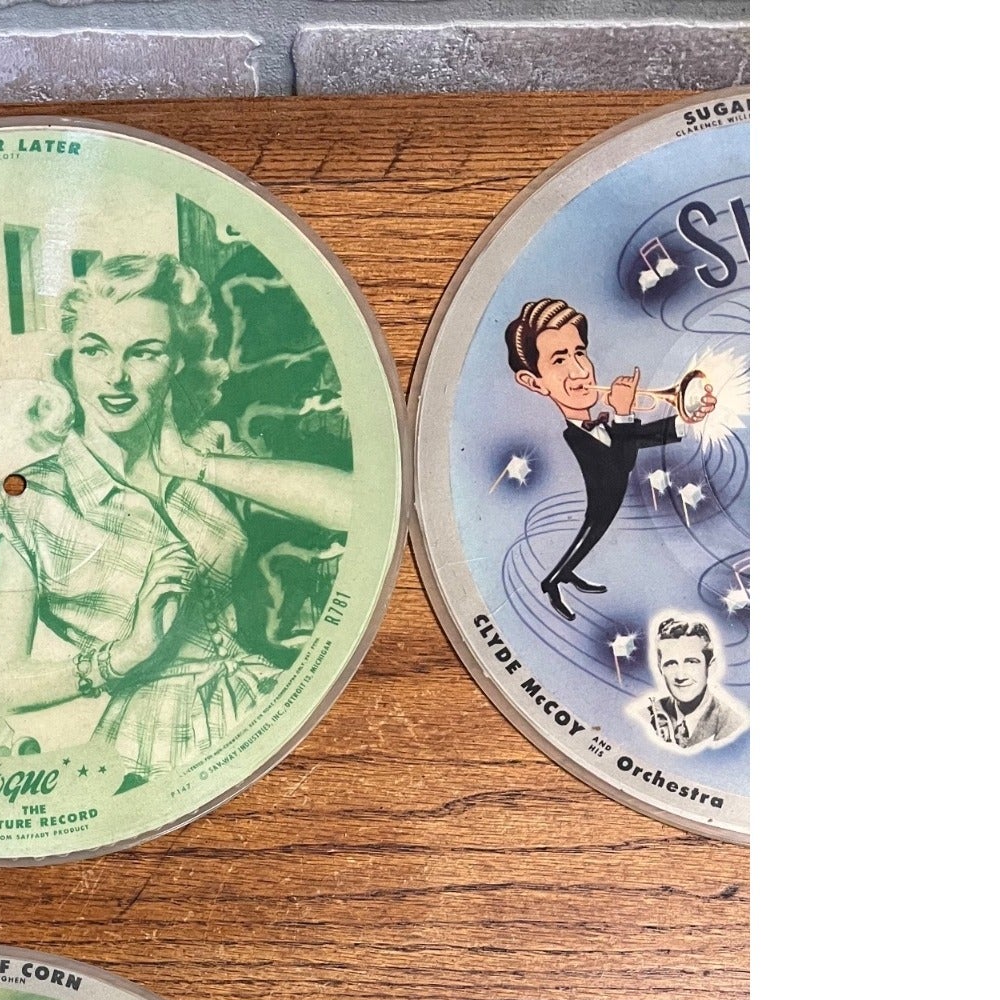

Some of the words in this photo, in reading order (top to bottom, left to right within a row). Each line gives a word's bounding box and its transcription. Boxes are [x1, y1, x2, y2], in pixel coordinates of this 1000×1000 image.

[683, 99, 750, 125] SUGA
[675, 119, 722, 137] CLARENCE
[18, 139, 81, 156] LATER
[324, 591, 351, 626] R781
[473, 614, 521, 675] CLYDE
[208, 751, 237, 773] SAV-WAY
[285, 682, 306, 708] DETROIT
[310, 640, 332, 674] MICHIGAN
[521, 678, 586, 736] McCOY
[588, 744, 605, 758] HIS
[592, 736, 612, 751] AND
[617, 756, 724, 809] Orchestra
[22, 804, 46, 815] THE
[40, 808, 98, 827] RECORD
[53, 824, 89, 836] PRODUCT
[21, 962, 83, 991] CORN
